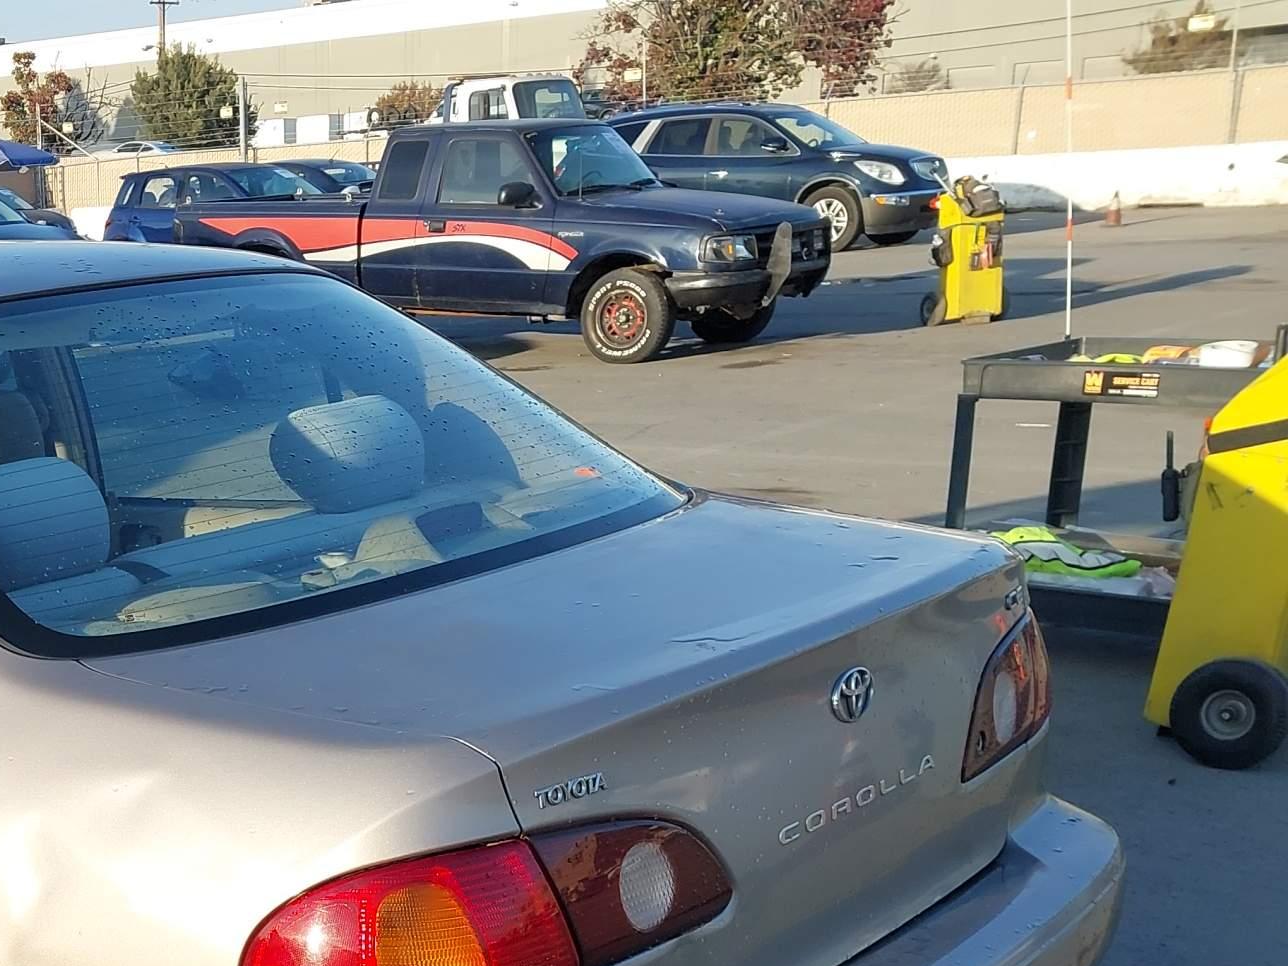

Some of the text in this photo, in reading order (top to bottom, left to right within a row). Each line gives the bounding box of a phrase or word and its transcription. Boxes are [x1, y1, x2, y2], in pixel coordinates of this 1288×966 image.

[452, 224, 466, 233] STX
[534, 772, 609, 809] TOYOTA
[778, 754, 936, 845] COROLLA
